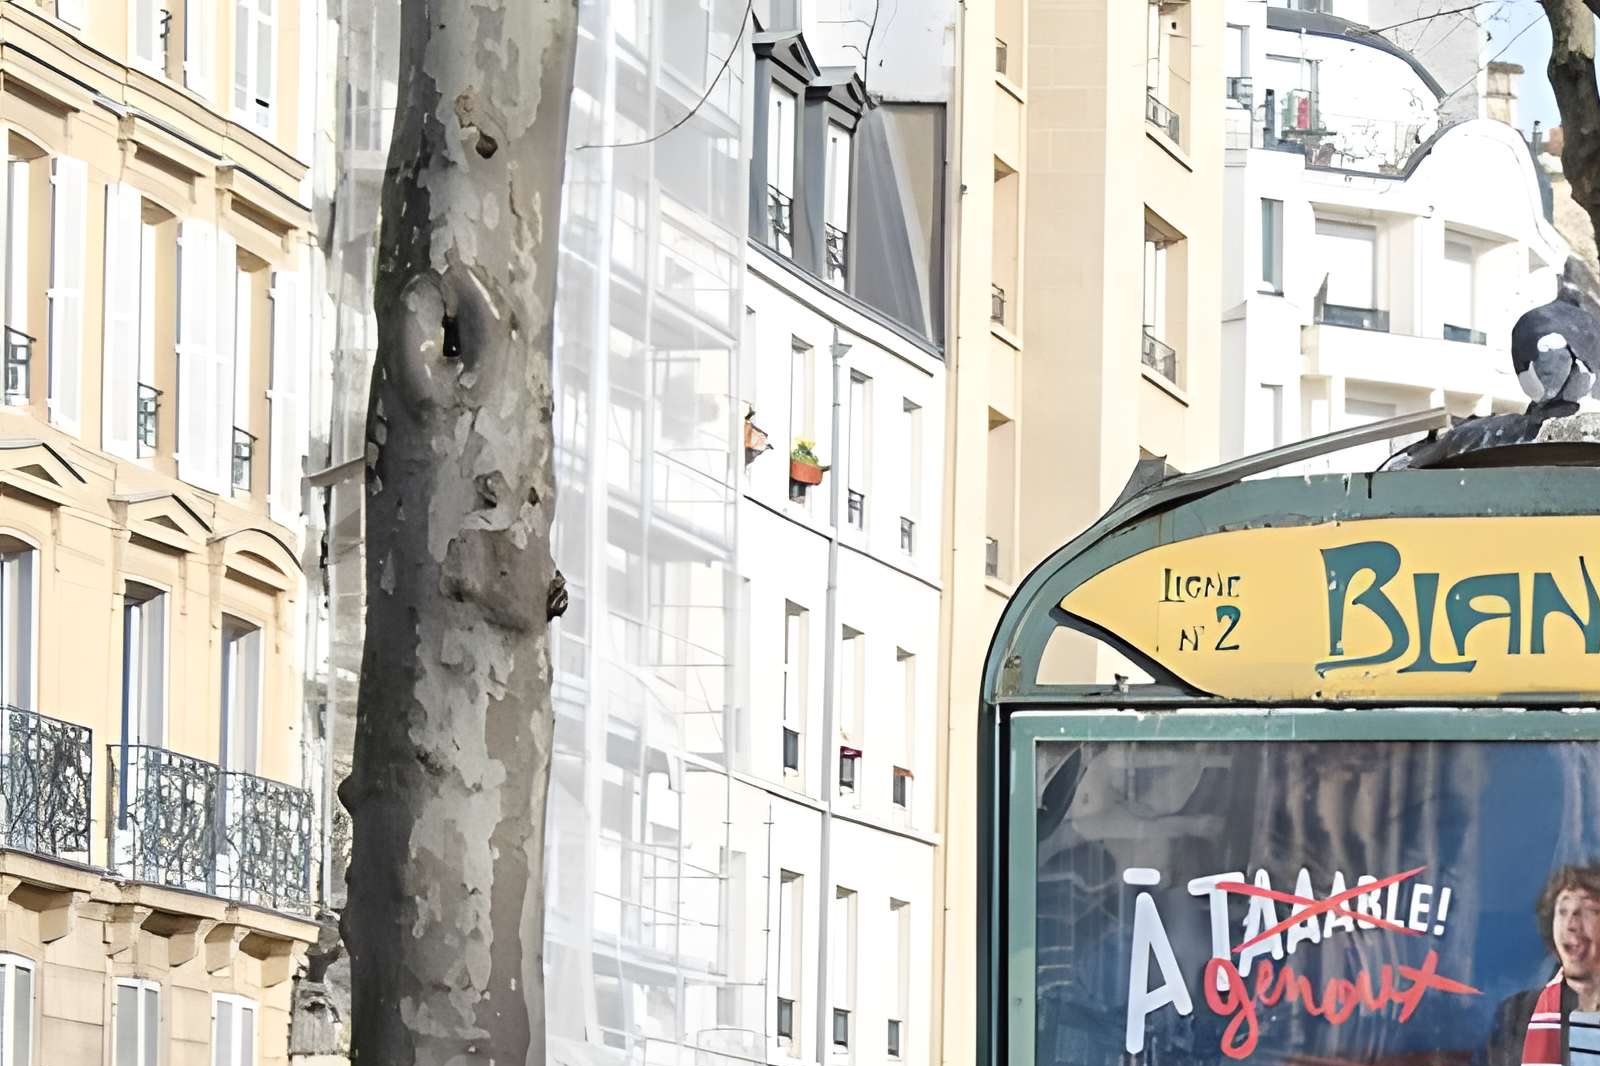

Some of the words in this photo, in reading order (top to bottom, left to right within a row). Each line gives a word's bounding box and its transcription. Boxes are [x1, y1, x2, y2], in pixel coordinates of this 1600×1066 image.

[1159, 567, 1241, 603] LIGNE
[1214, 604, 1242, 651] 2
[1203, 949, 1486, 1061] genoux
